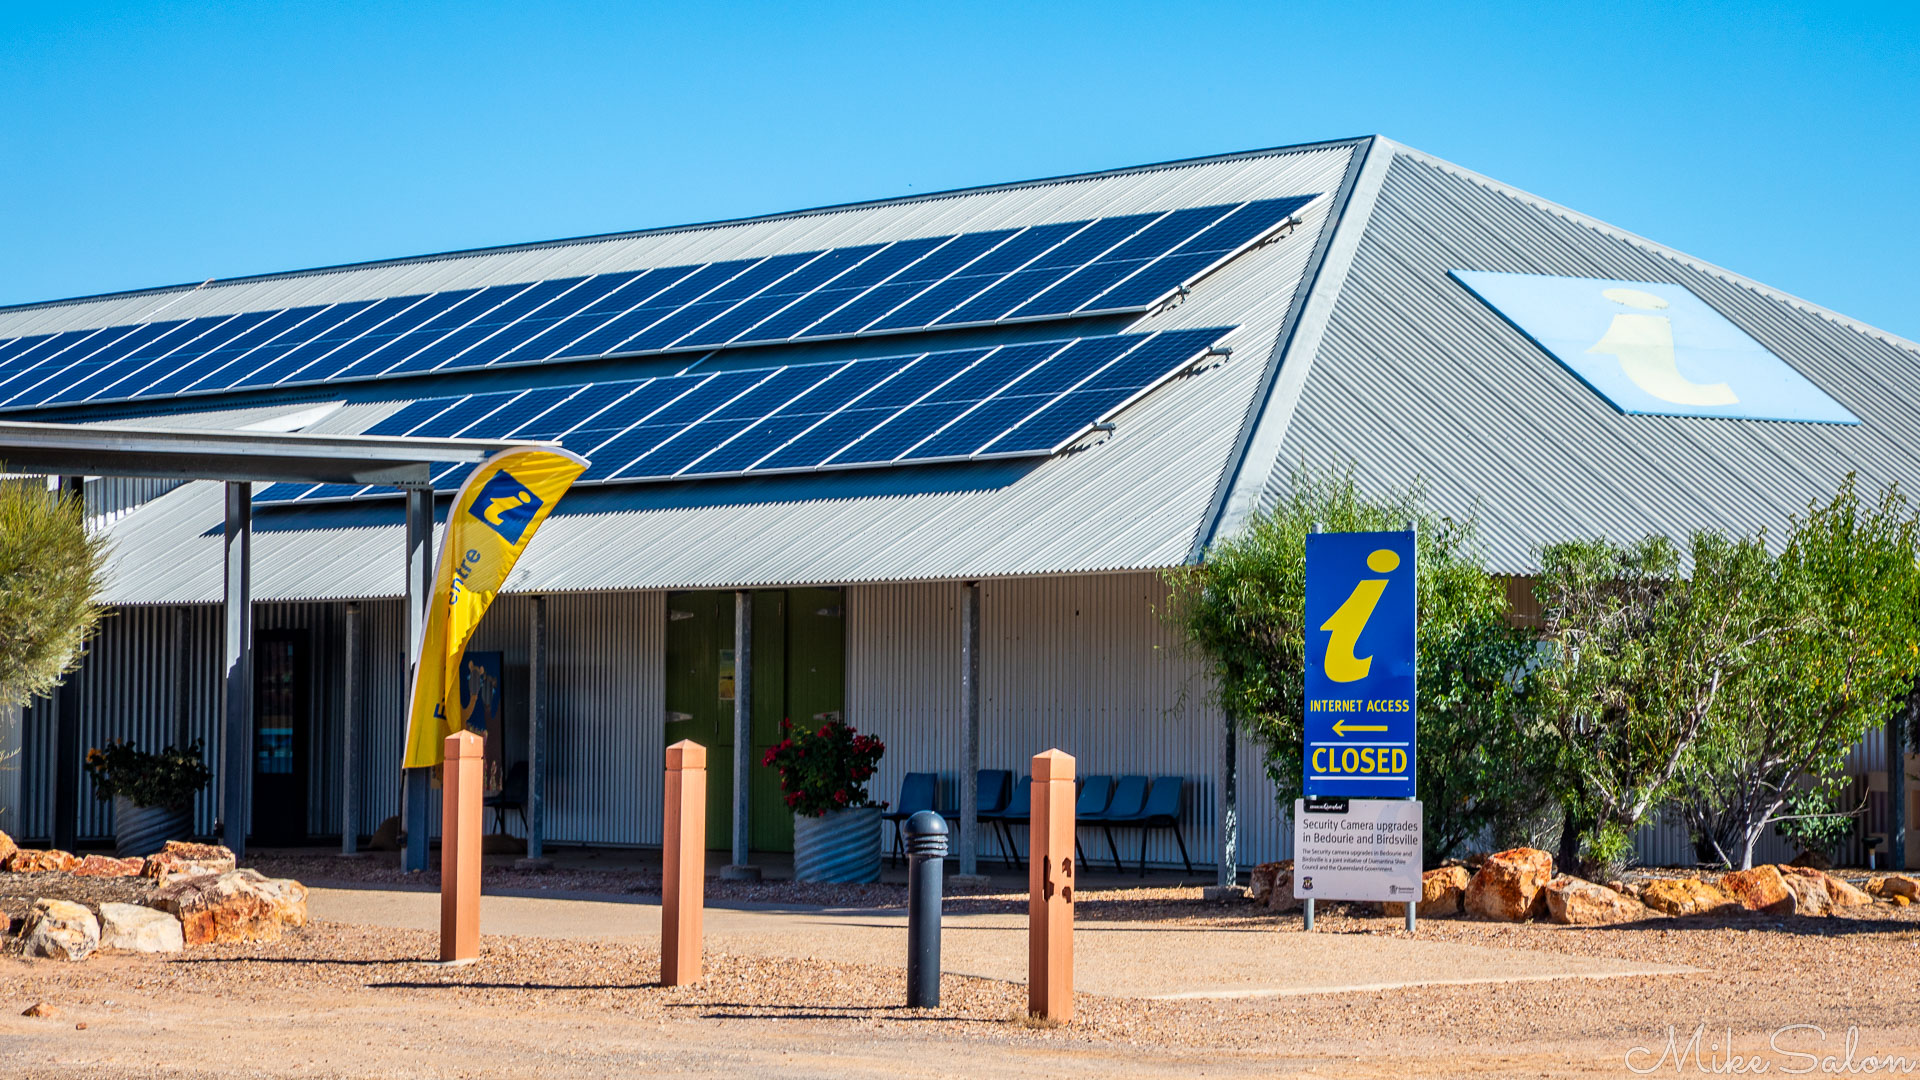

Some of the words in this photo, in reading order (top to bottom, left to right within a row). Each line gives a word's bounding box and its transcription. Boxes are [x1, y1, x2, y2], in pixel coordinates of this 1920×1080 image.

[448, 549, 481, 617] entre
[1310, 699, 1363, 712] INTERNET
[1366, 699, 1410, 712] ACCESS
[1312, 747, 1408, 773] CLOSED
[1303, 819, 1339, 831] Security
[1340, 820, 1374, 831] Camera
[1376, 820, 1418, 833] upgrades
[1303, 832, 1311, 843] in
[1313, 832, 1354, 844] Bedourie
[1356, 833, 1374, 844] and
[1376, 834, 1418, 845] Birdsville
[1311, 848, 1331, 857] Security
[1350, 849, 1373, 857] upgrades
